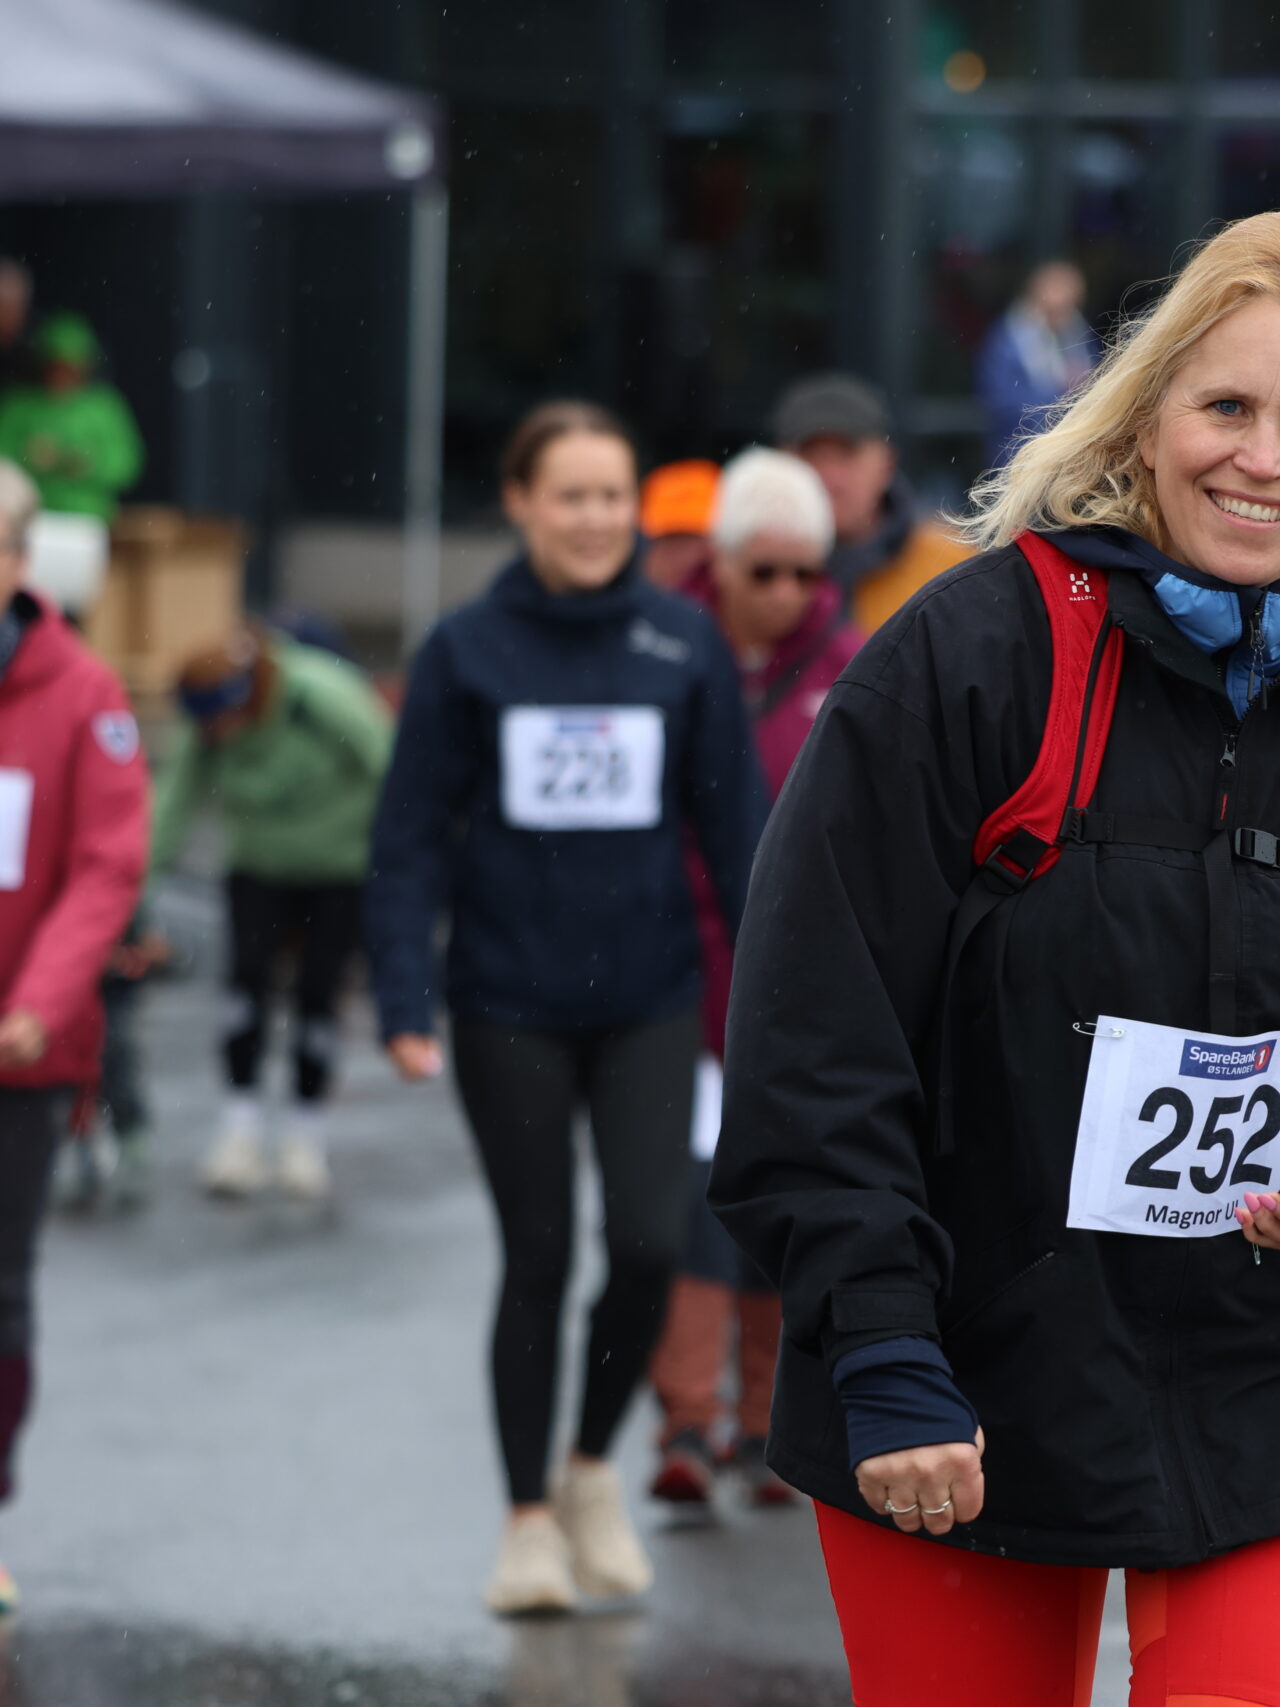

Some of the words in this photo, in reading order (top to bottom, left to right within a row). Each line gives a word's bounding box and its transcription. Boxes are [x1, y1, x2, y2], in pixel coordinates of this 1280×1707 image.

[1189, 1046, 1257, 1065] SpareBank
[1207, 1064, 1255, 1075] ØSTLANDET
[1145, 1204, 1223, 1230] Magnor
